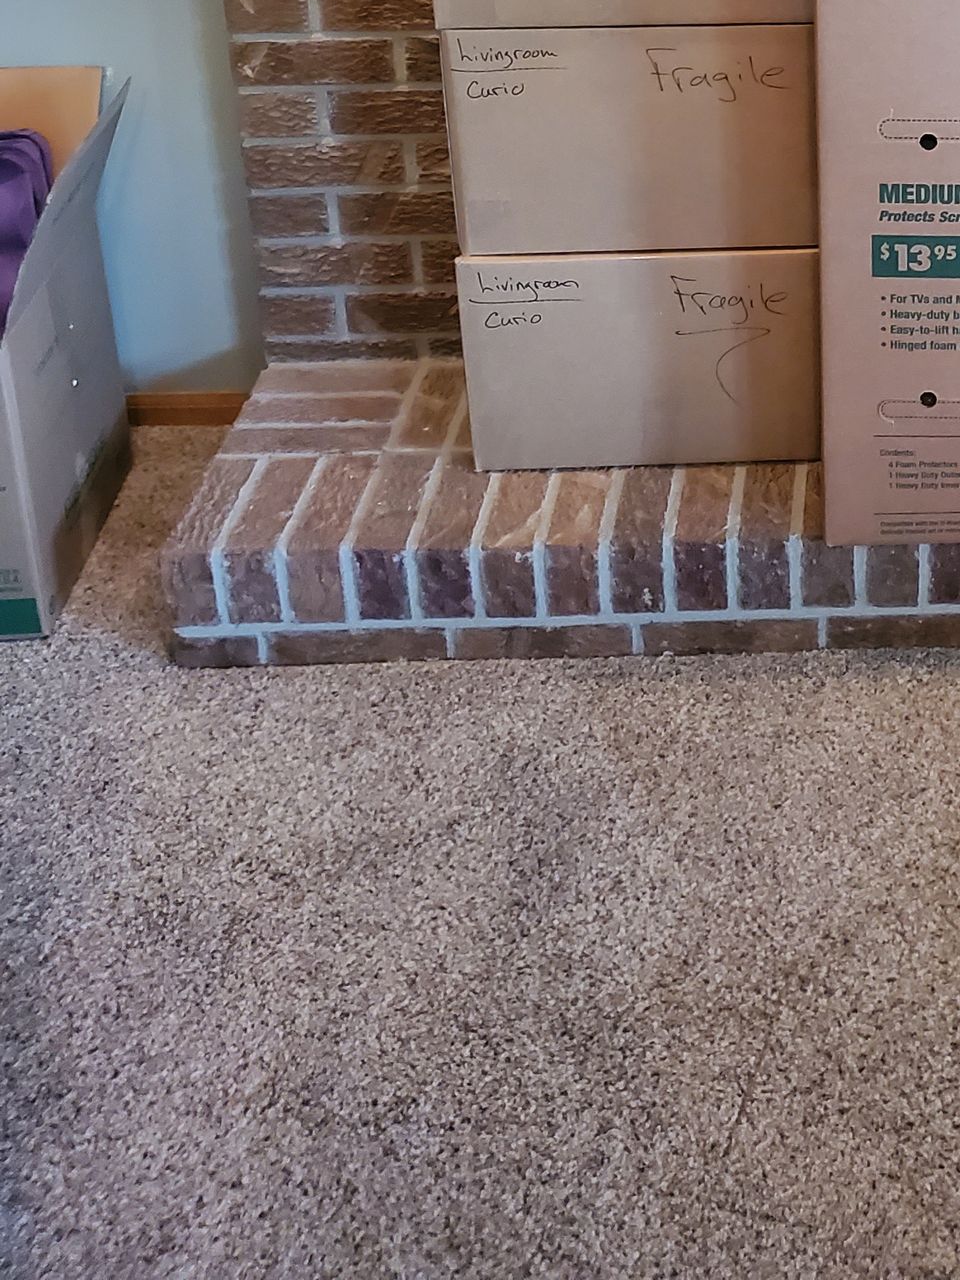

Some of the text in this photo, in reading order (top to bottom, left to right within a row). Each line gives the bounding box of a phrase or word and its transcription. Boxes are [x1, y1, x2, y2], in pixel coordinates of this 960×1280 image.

[645, 47, 794, 102] Fragile
[878, 210, 936, 223] Protects
[669, 275, 789, 325] Fragile
[889, 294, 908, 304] For
[910, 294, 931, 304] TVs
[932, 294, 953, 305] and
[889, 309, 951, 322] Heavy-duty
[889, 325, 951, 337] Easy-to-lift
[889, 340, 928, 352] Hinged
[929, 340, 957, 351] foam
